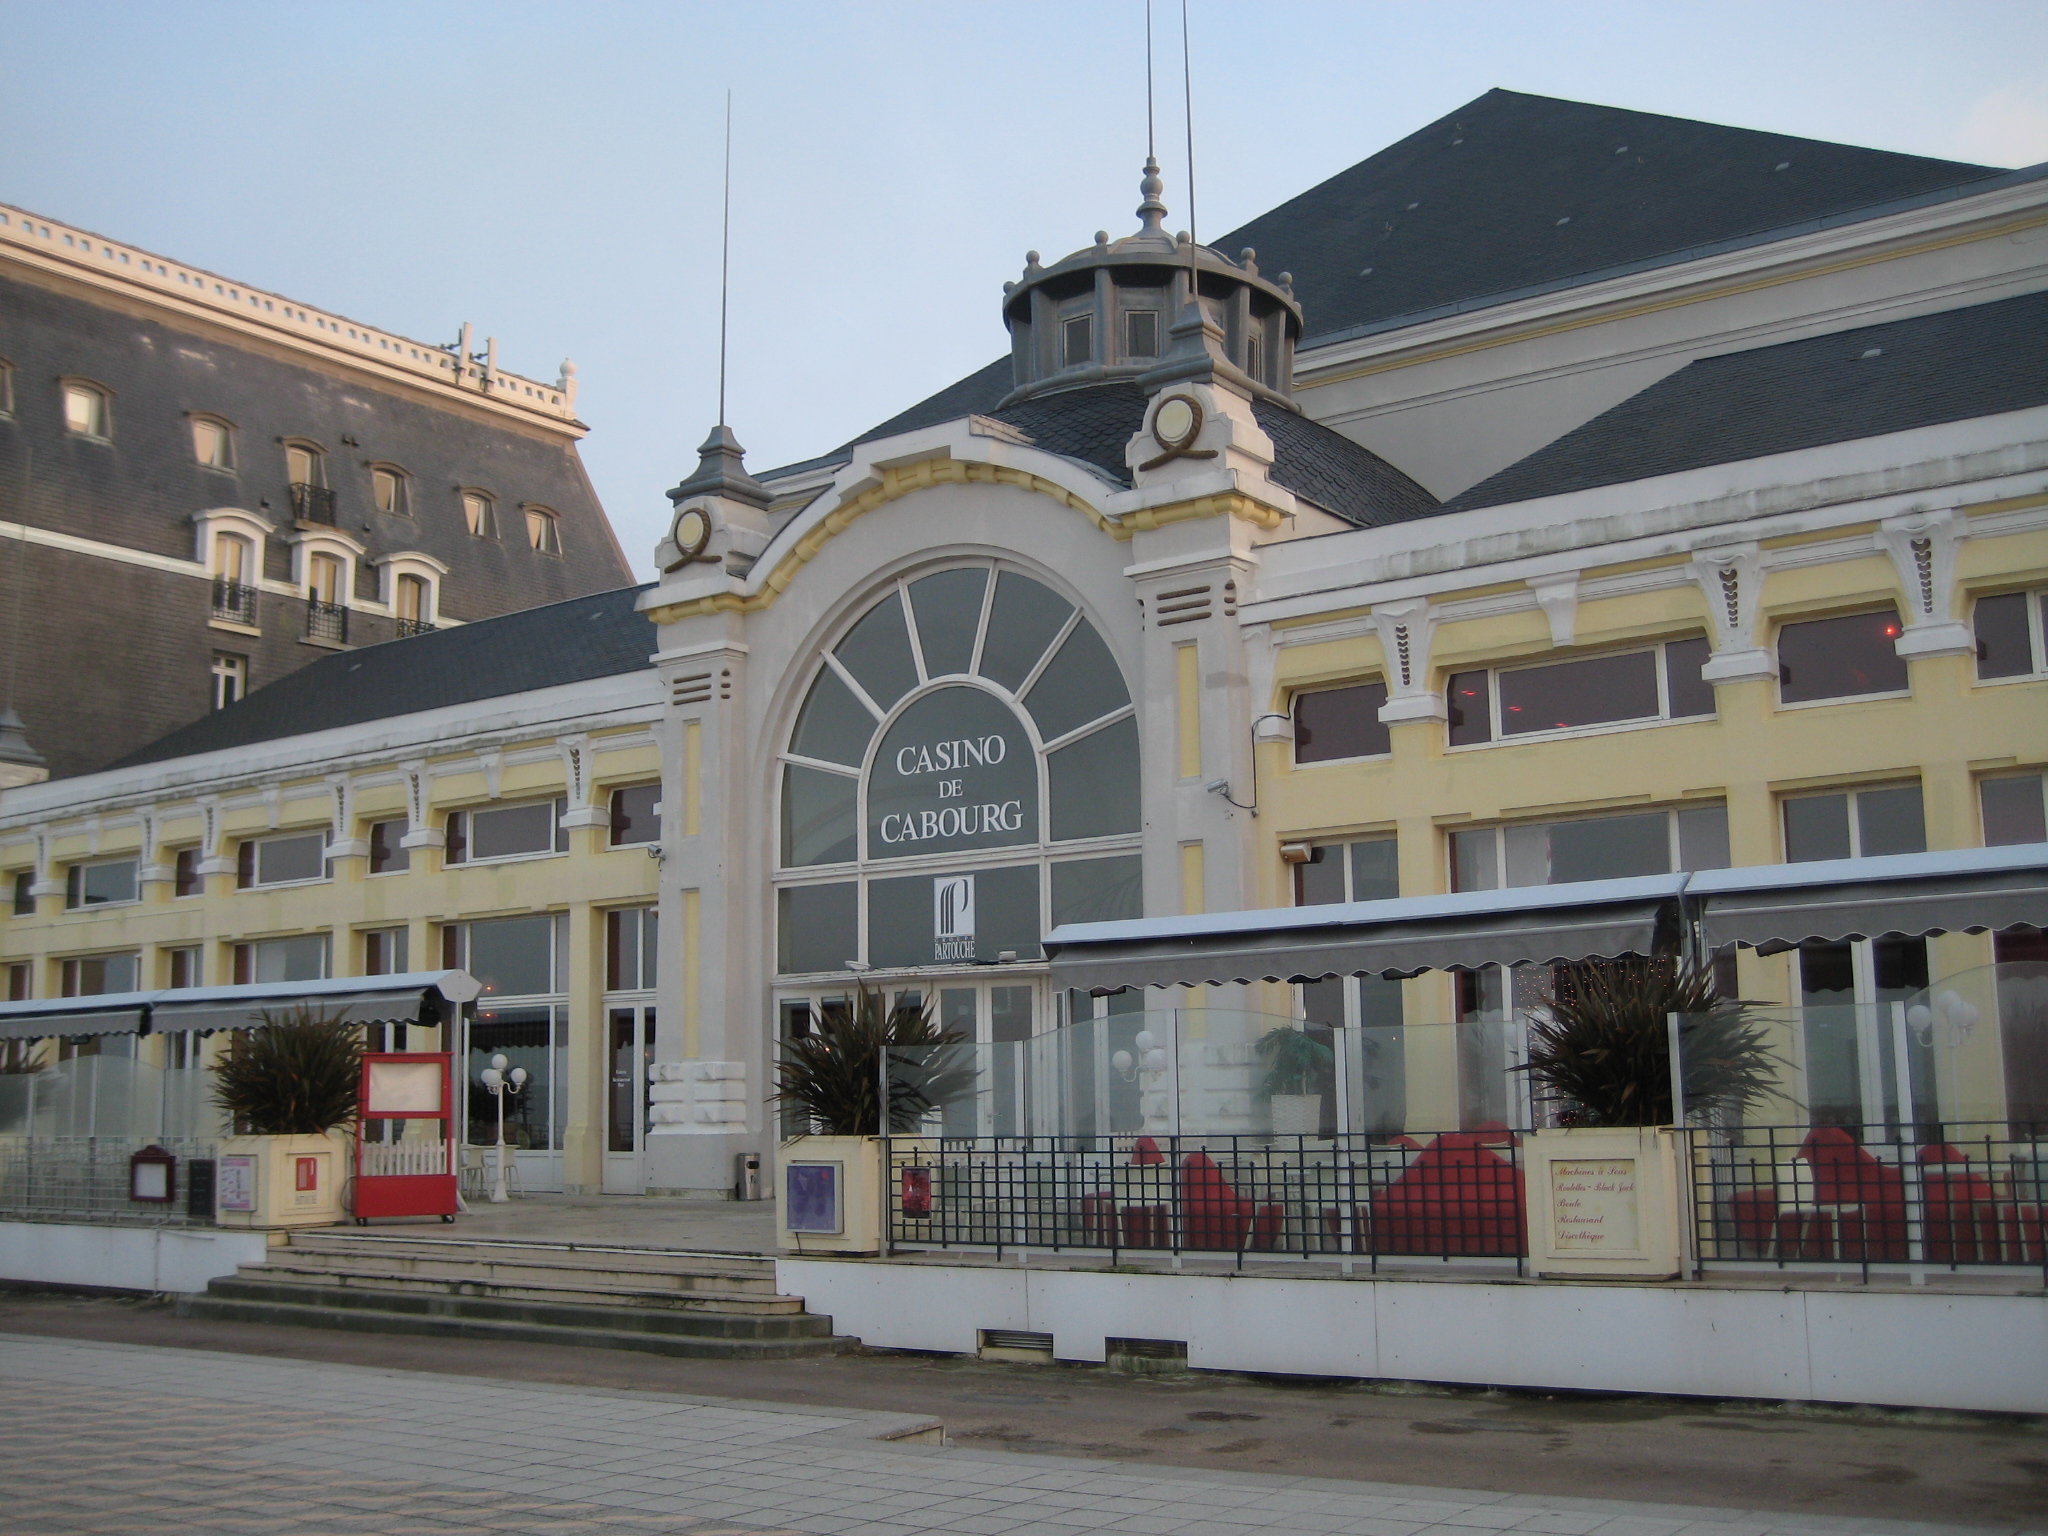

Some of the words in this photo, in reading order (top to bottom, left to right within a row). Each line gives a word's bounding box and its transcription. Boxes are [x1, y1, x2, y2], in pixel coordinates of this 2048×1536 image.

[896, 734, 1006, 776] CASINO
[938, 778, 964, 799] DE
[880, 800, 1024, 844] CABOURG
[934, 941, 976, 961] PARTOUCHE
[1555, 1166, 1594, 1176] Machines
[1555, 1183, 1586, 1192] Roulettes
[1594, 1182, 1615, 1191] Black
[1617, 1183, 1634, 1194] Jack
[1556, 1199, 1582, 1208] Boule
[1557, 1214, 1604, 1224] Restaurant
[1557, 1230, 1605, 1243] Discothèque
